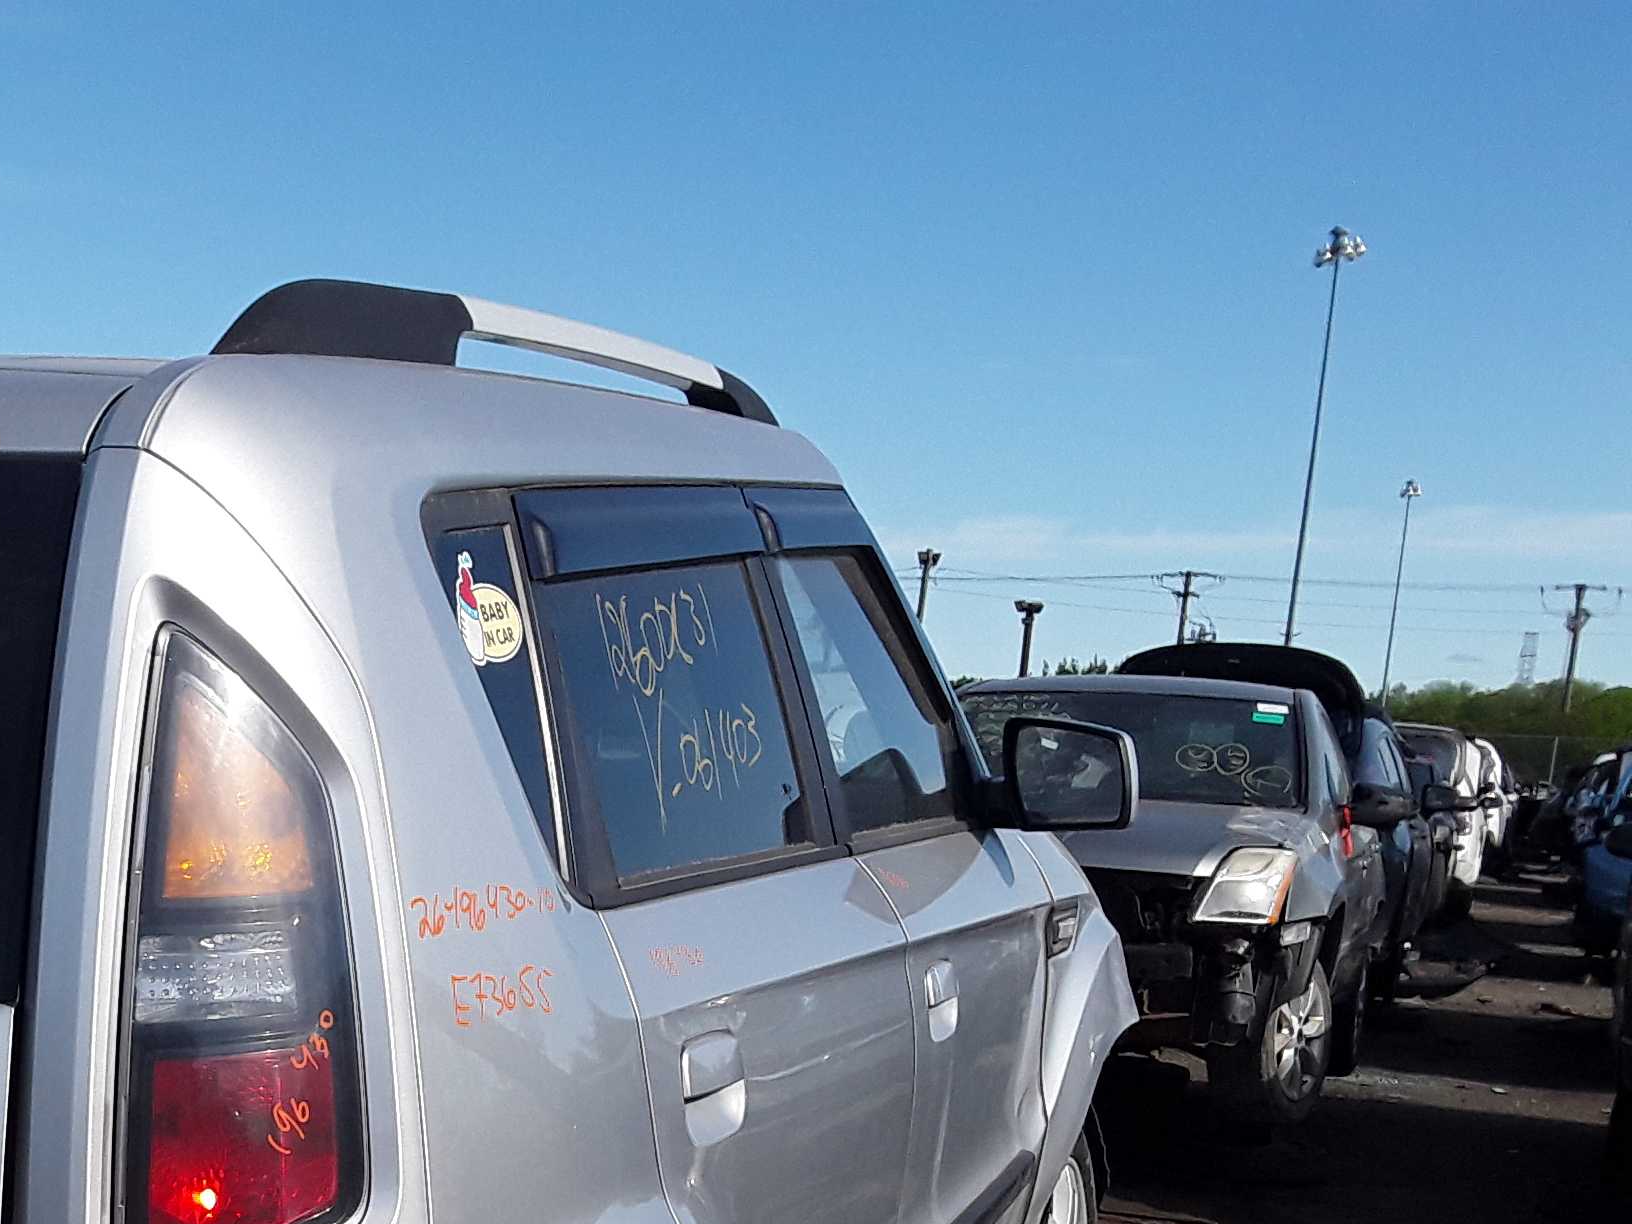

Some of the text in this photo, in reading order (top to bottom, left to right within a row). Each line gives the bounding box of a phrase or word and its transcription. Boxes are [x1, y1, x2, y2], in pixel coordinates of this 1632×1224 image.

[479, 601, 511, 622] BABY
[484, 626, 515, 648] IN CAR
